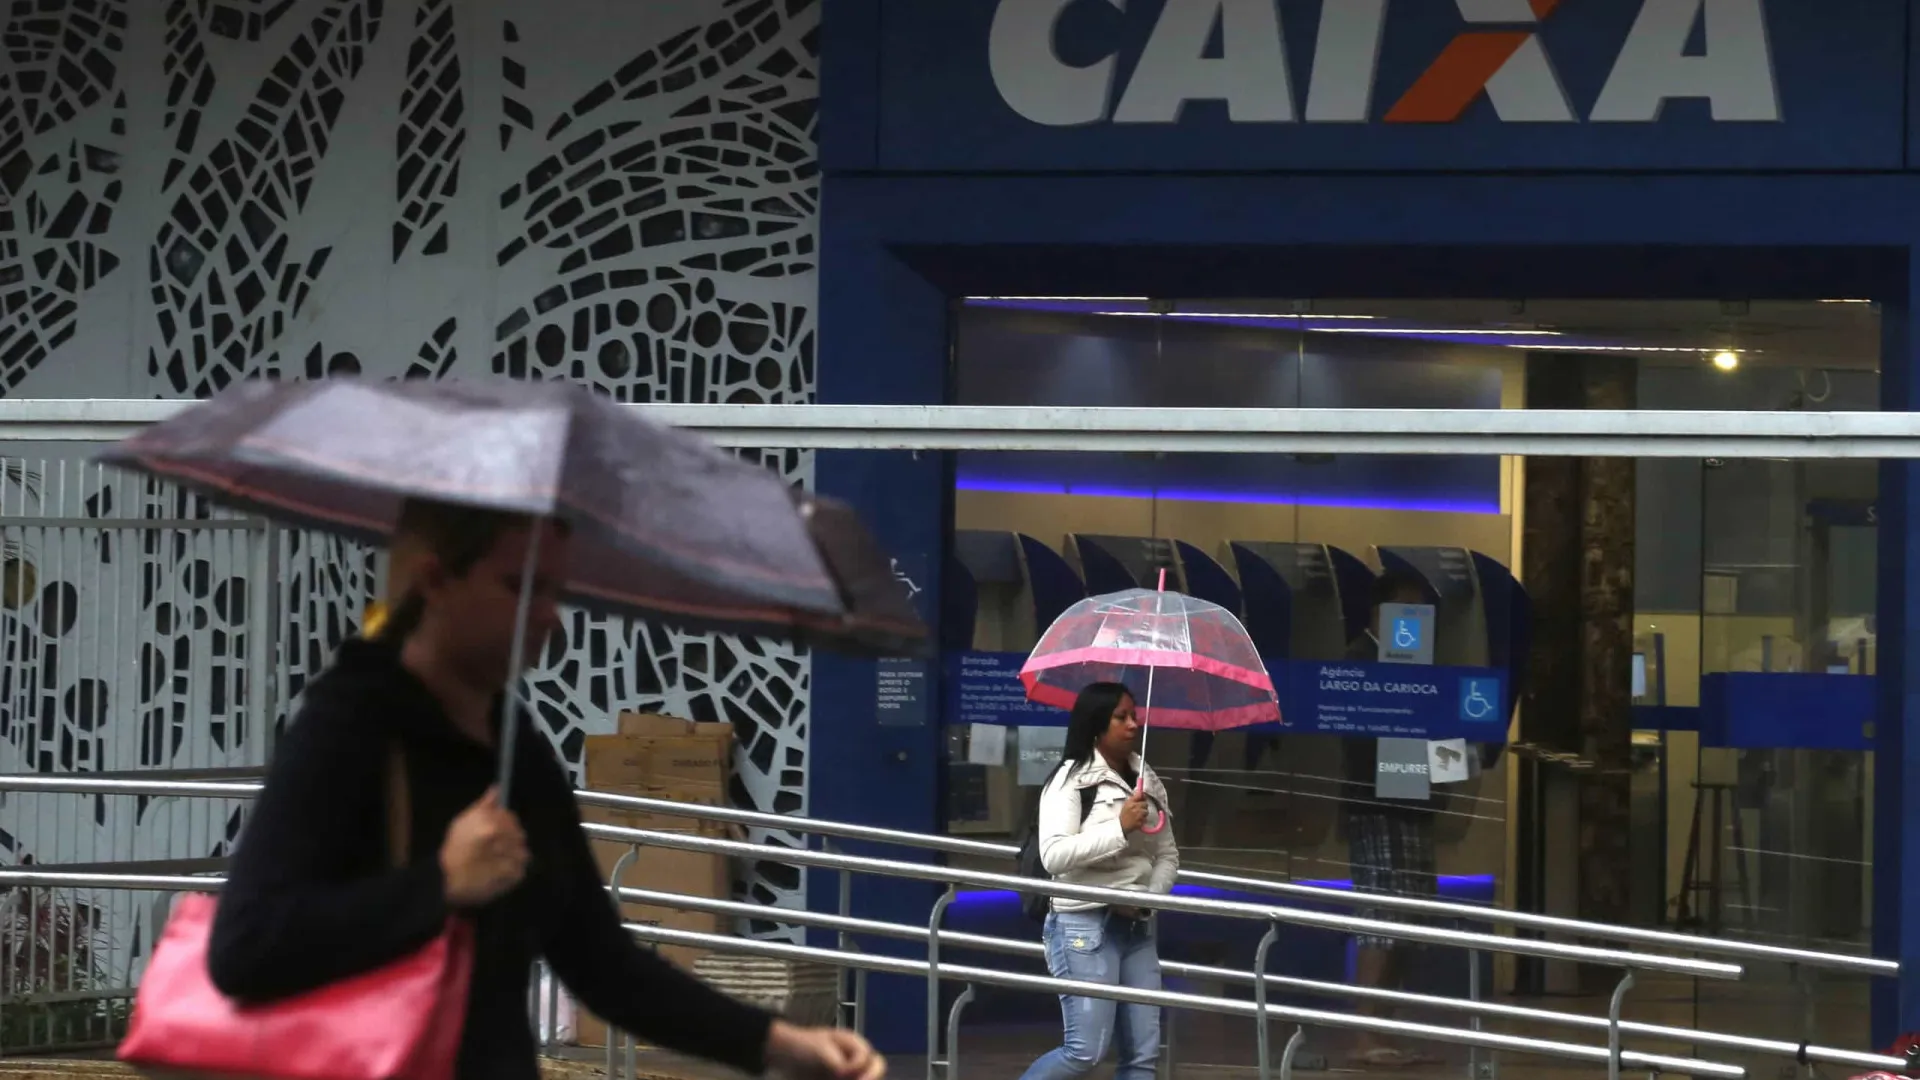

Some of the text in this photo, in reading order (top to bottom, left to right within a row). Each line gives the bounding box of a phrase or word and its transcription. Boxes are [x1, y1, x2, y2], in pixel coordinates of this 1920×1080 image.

[989, 0, 1783, 126] CAIXA
[962, 668, 1017, 678] Auto-atend
[1320, 666, 1365, 678] Agência
[1320, 680, 1438, 694] LARGO DA CARIOCA
[1379, 762, 1429, 775] EMPURRE
